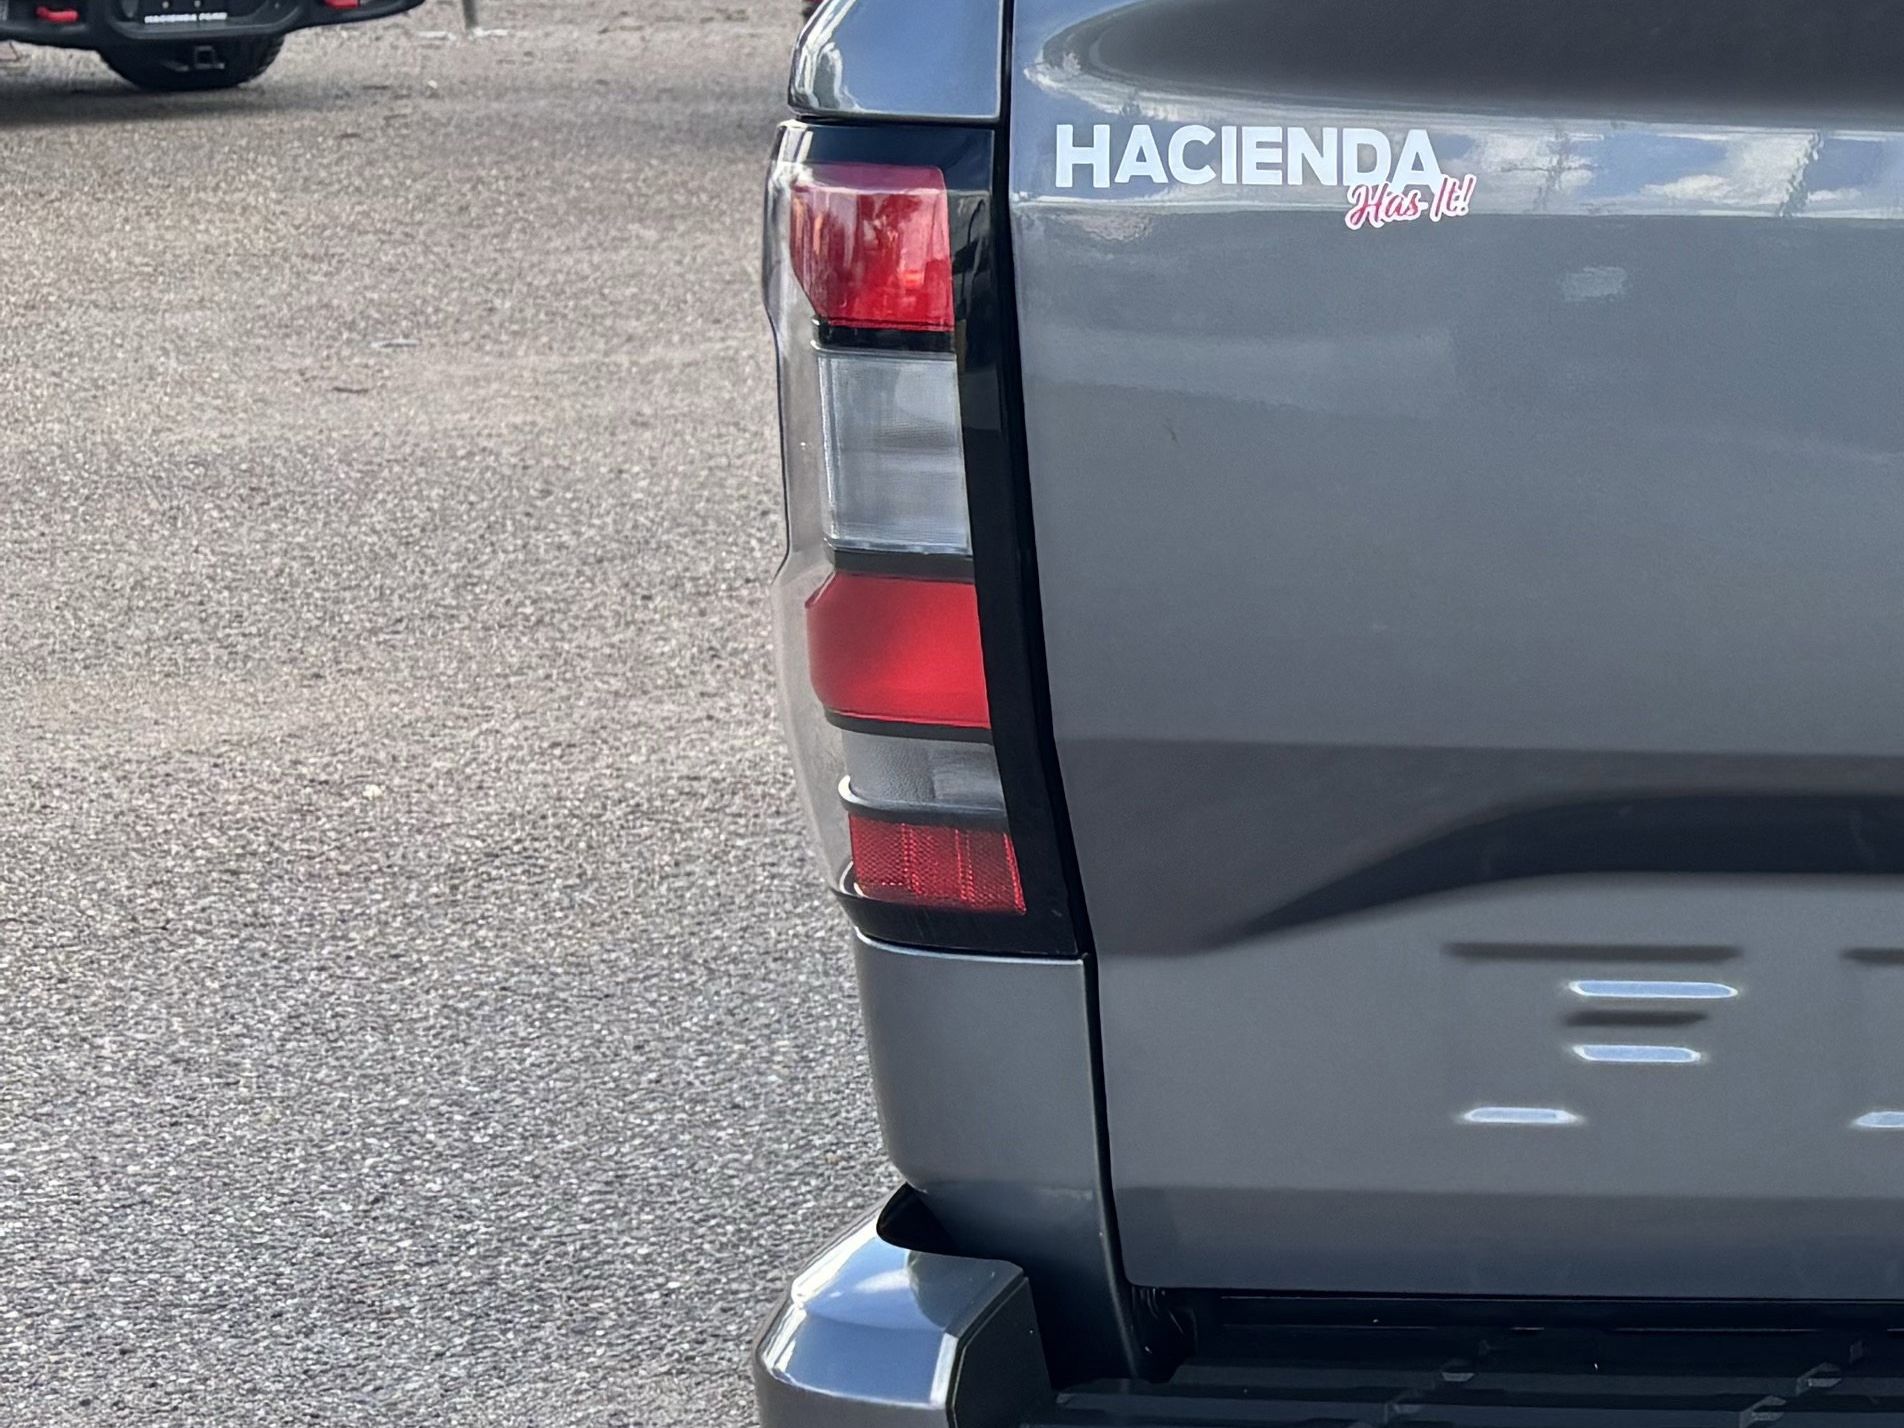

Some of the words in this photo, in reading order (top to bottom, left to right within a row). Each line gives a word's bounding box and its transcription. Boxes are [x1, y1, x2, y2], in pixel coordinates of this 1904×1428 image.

[1055, 123, 1443, 190] HACIENDA
[1346, 181, 1422, 228] Has
[1432, 175, 1476, 220] It!
